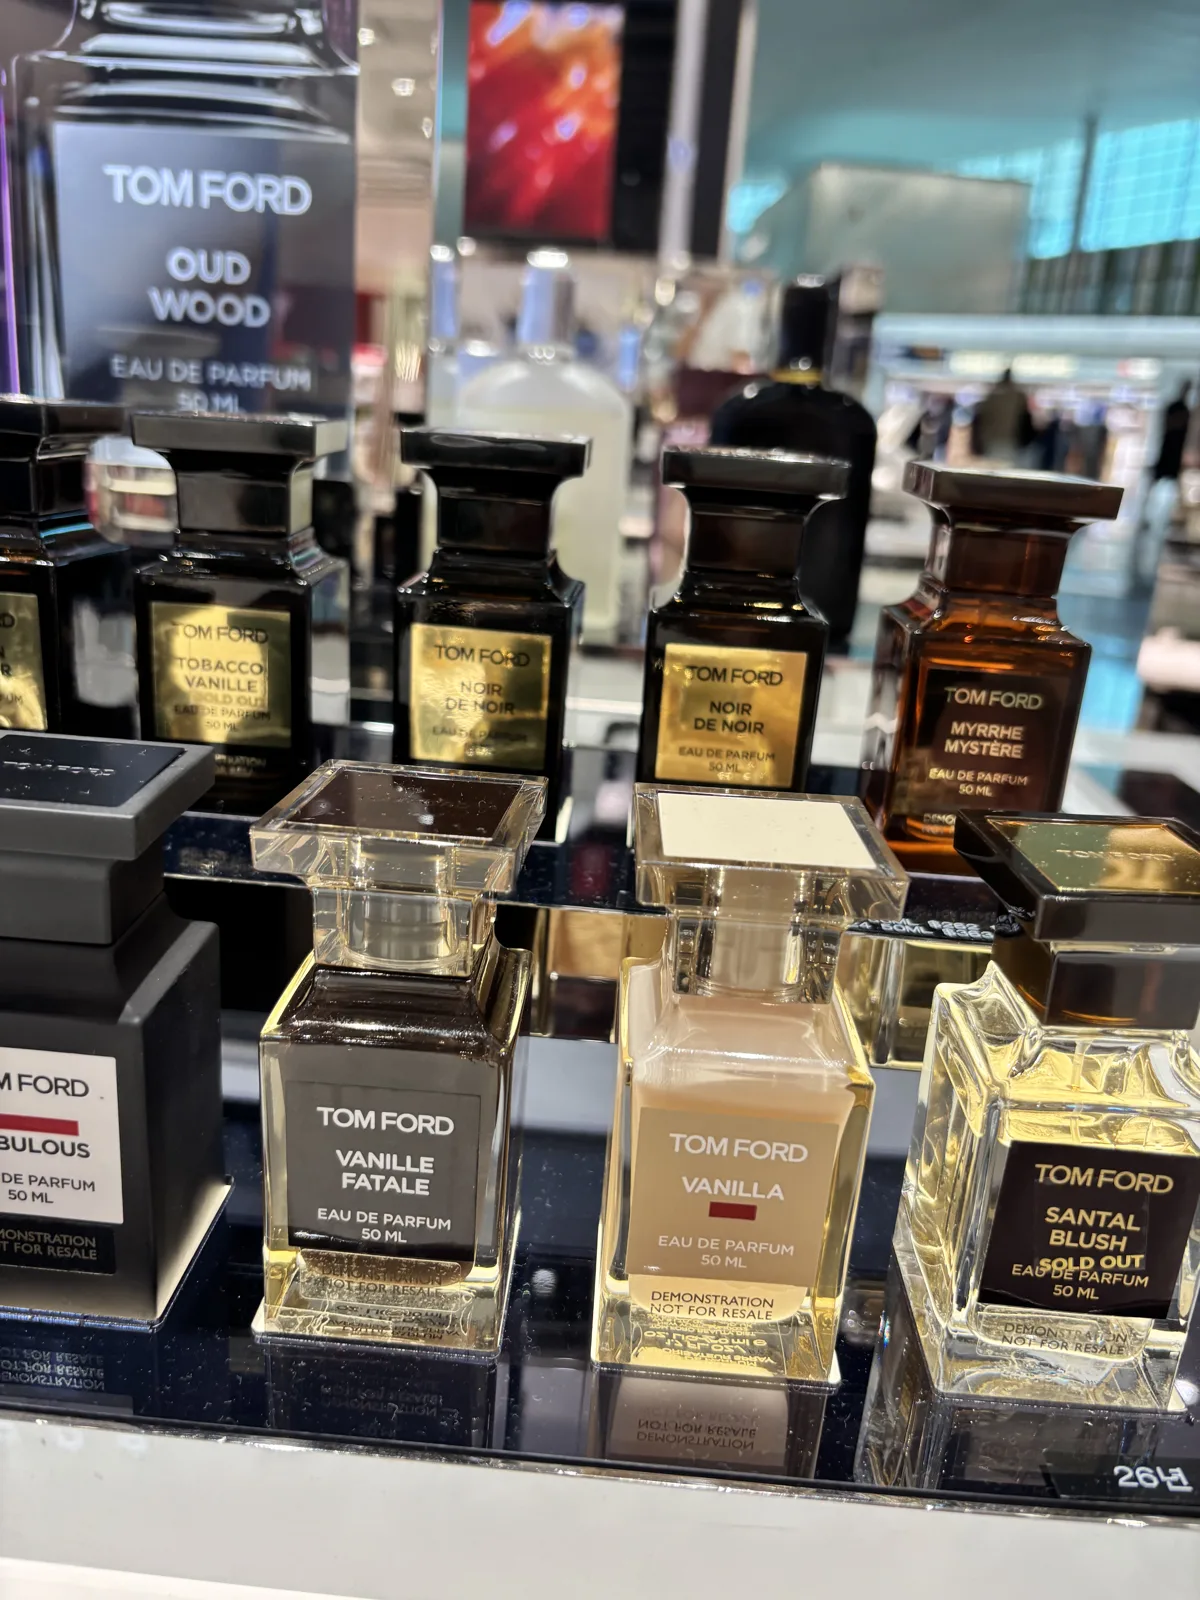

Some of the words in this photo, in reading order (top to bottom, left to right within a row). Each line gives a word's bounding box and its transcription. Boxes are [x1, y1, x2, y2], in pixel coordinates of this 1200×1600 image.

[103, 165, 193, 208] TOM
[201, 170, 312, 215] FORD
[166, 247, 251, 285] OUD
[148, 287, 270, 327] WOOD
[111, 355, 164, 381] EAU
[168, 359, 200, 383] DE
[207, 362, 312, 391] PARFUM
[172, 621, 212, 640] TOM
[216, 626, 269, 644] FORD
[434, 644, 475, 662] TOM
[479, 649, 531, 667] FORD
[176, 657, 264, 675] TOBACCO
[686, 665, 726, 682] TOM
[730, 668, 783, 686] FORD
[185, 675, 258, 693] VANILLE
[460, 681, 503, 696] NOIR
[445, 697, 469, 711] DE
[473, 699, 515, 715] NOIR
[709, 701, 752, 716] NOIR
[944, 687, 985, 706] TOM
[989, 691, 1042, 710] FORD
[174, 705, 198, 715] EAU
[221, 708, 270, 720] PARFUM
[694, 718, 716, 731] DE
[721, 719, 764, 735] NOIR
[951, 721, 1024, 741] MYRRHE
[678, 746, 702, 757] EAU
[706, 749, 722, 759] DE
[725, 750, 775, 762] PARFUM
[944, 739, 1024, 759] MYSTÈRE
[708, 762, 724, 772] 50
[725, 763, 741, 773] ML
[929, 767, 954, 780] EAU
[957, 770, 975, 781] DE
[977, 773, 1028, 785] PARFUM
[958, 784, 974, 795] 50
[975, 785, 993, 797] ML
[881, 923, 934, 935] 50ML
[18, 1073, 90, 1098] FORD
[316, 1107, 376, 1130] TOM
[381, 1111, 455, 1136] FORD
[669, 1132, 728, 1157] TOM
[733, 1138, 808, 1163] FORD
[335, 1149, 435, 1174] VANILLE
[1, 1172, 24, 1185] DE
[28, 1175, 96, 1192] PARFUM
[341, 1172, 430, 1195] FATALE
[681, 1176, 785, 1200] VANILLA
[1034, 1163, 1093, 1187] TOM
[1097, 1168, 1174, 1194] FORD
[8, 1189, 28, 1201] 50
[31, 1191, 54, 1204] ML
[317, 1208, 351, 1222] EAU
[356, 1211, 379, 1224] DE
[383, 1214, 451, 1230] PARFUM
[1045, 1206, 1141, 1231] SANTAL
[361, 1228, 381, 1240] 50
[384, 1230, 407, 1243] ML
[658, 1235, 692, 1248] EAU
[697, 1238, 721, 1250] DE
[725, 1239, 794, 1256] PARFUM
[1049, 1229, 1128, 1252] BLUSH
[14, 1242, 43, 1255] FOR
[47, 1246, 97, 1260] RESALE
[700, 1254, 721, 1266] 50
[725, 1256, 747, 1269] ML
[1038, 1256, 1095, 1272] SOLD
[1100, 1254, 1145, 1269] OUT
[1011, 1264, 1047, 1278] EAU
[1051, 1268, 1073, 1281] DE
[1078, 1270, 1149, 1288] PARFUM
[321, 1277, 351, 1292] NOT
[358, 1282, 387, 1294] FOR
[392, 1285, 440, 1297] RESALE
[1052, 1284, 1073, 1297] 50
[1077, 1287, 1099, 1300] ML
[651, 1290, 774, 1308] DEMONSTRATION
[650, 1303, 683, 1315] NOT
[688, 1305, 716, 1317] FOR
[721, 1308, 773, 1320] RESALE
[1001, 1334, 1033, 1347] NOT
[1039, 1338, 1068, 1350] FOR
[1074, 1342, 1125, 1355] RESALE
